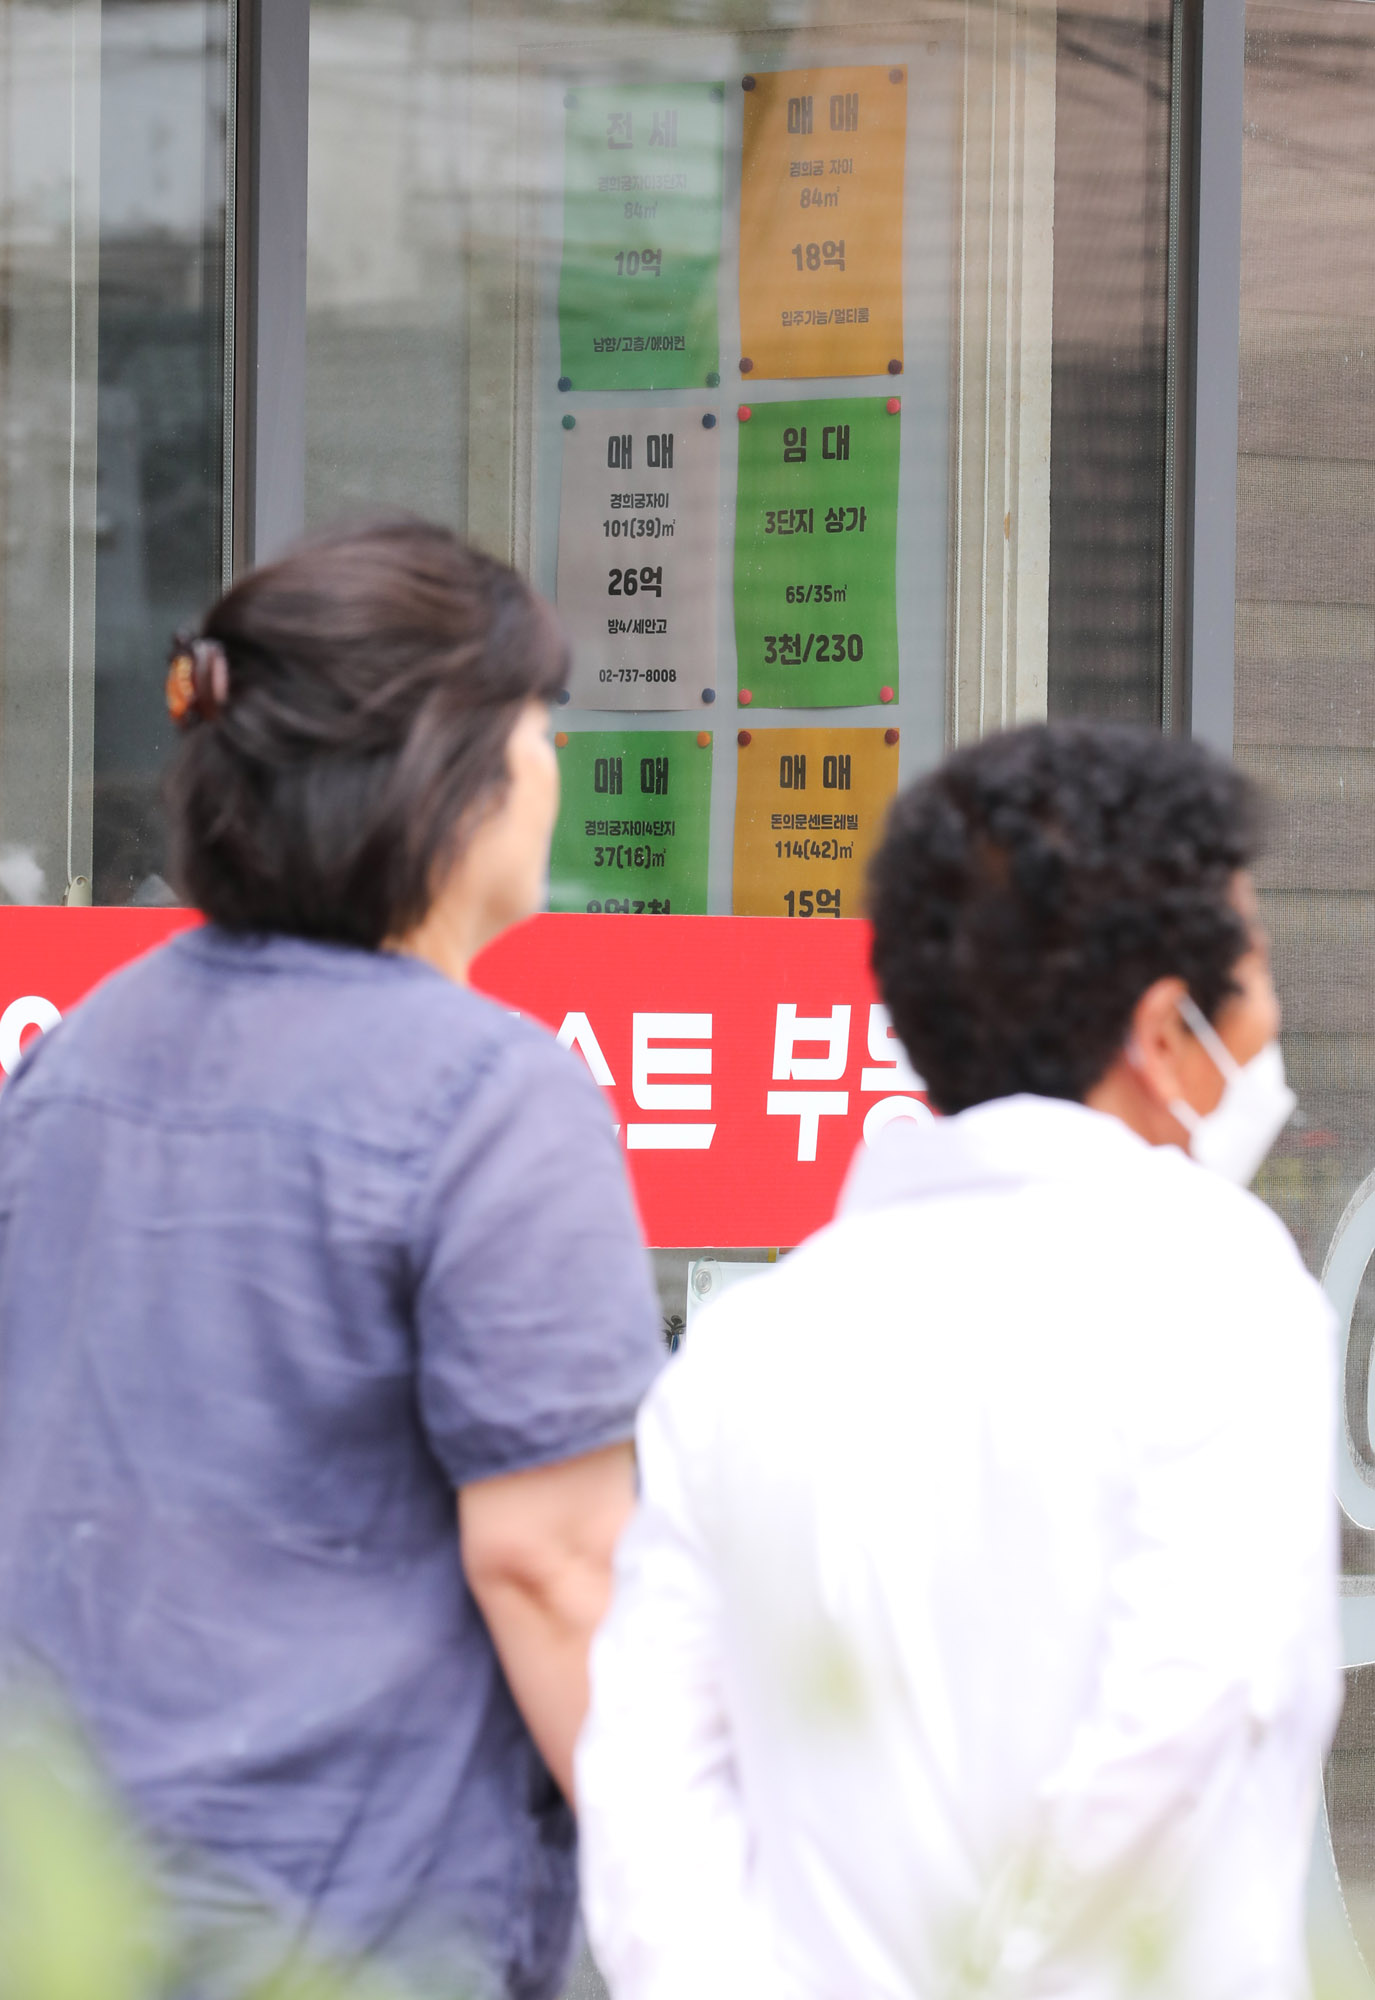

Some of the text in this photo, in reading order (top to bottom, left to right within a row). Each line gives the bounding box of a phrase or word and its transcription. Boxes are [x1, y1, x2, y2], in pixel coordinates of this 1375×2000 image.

[789, 158, 853, 177] 경희궁 자이
[614, 248, 662, 277] 10억
[791, 239, 845, 271] 18억
[781, 307, 869, 327] 입주가능/멀티룸
[593, 336, 685, 352] 남향/고층/에어컨
[610, 493, 669, 509] 경희궁자이
[765, 506, 867, 535] 3단지 상가
[608, 566, 662, 597] 26억
[608, 619, 667, 634] 방4/세안고
[764, 633, 864, 665] 3천/230
[599, 669, 677, 682] 02-737-8008
[585, 820, 675, 836] 경희궁자이4단지
[771, 814, 858, 830] 돈의문센트레빌
[784, 889, 841, 918] 15억
